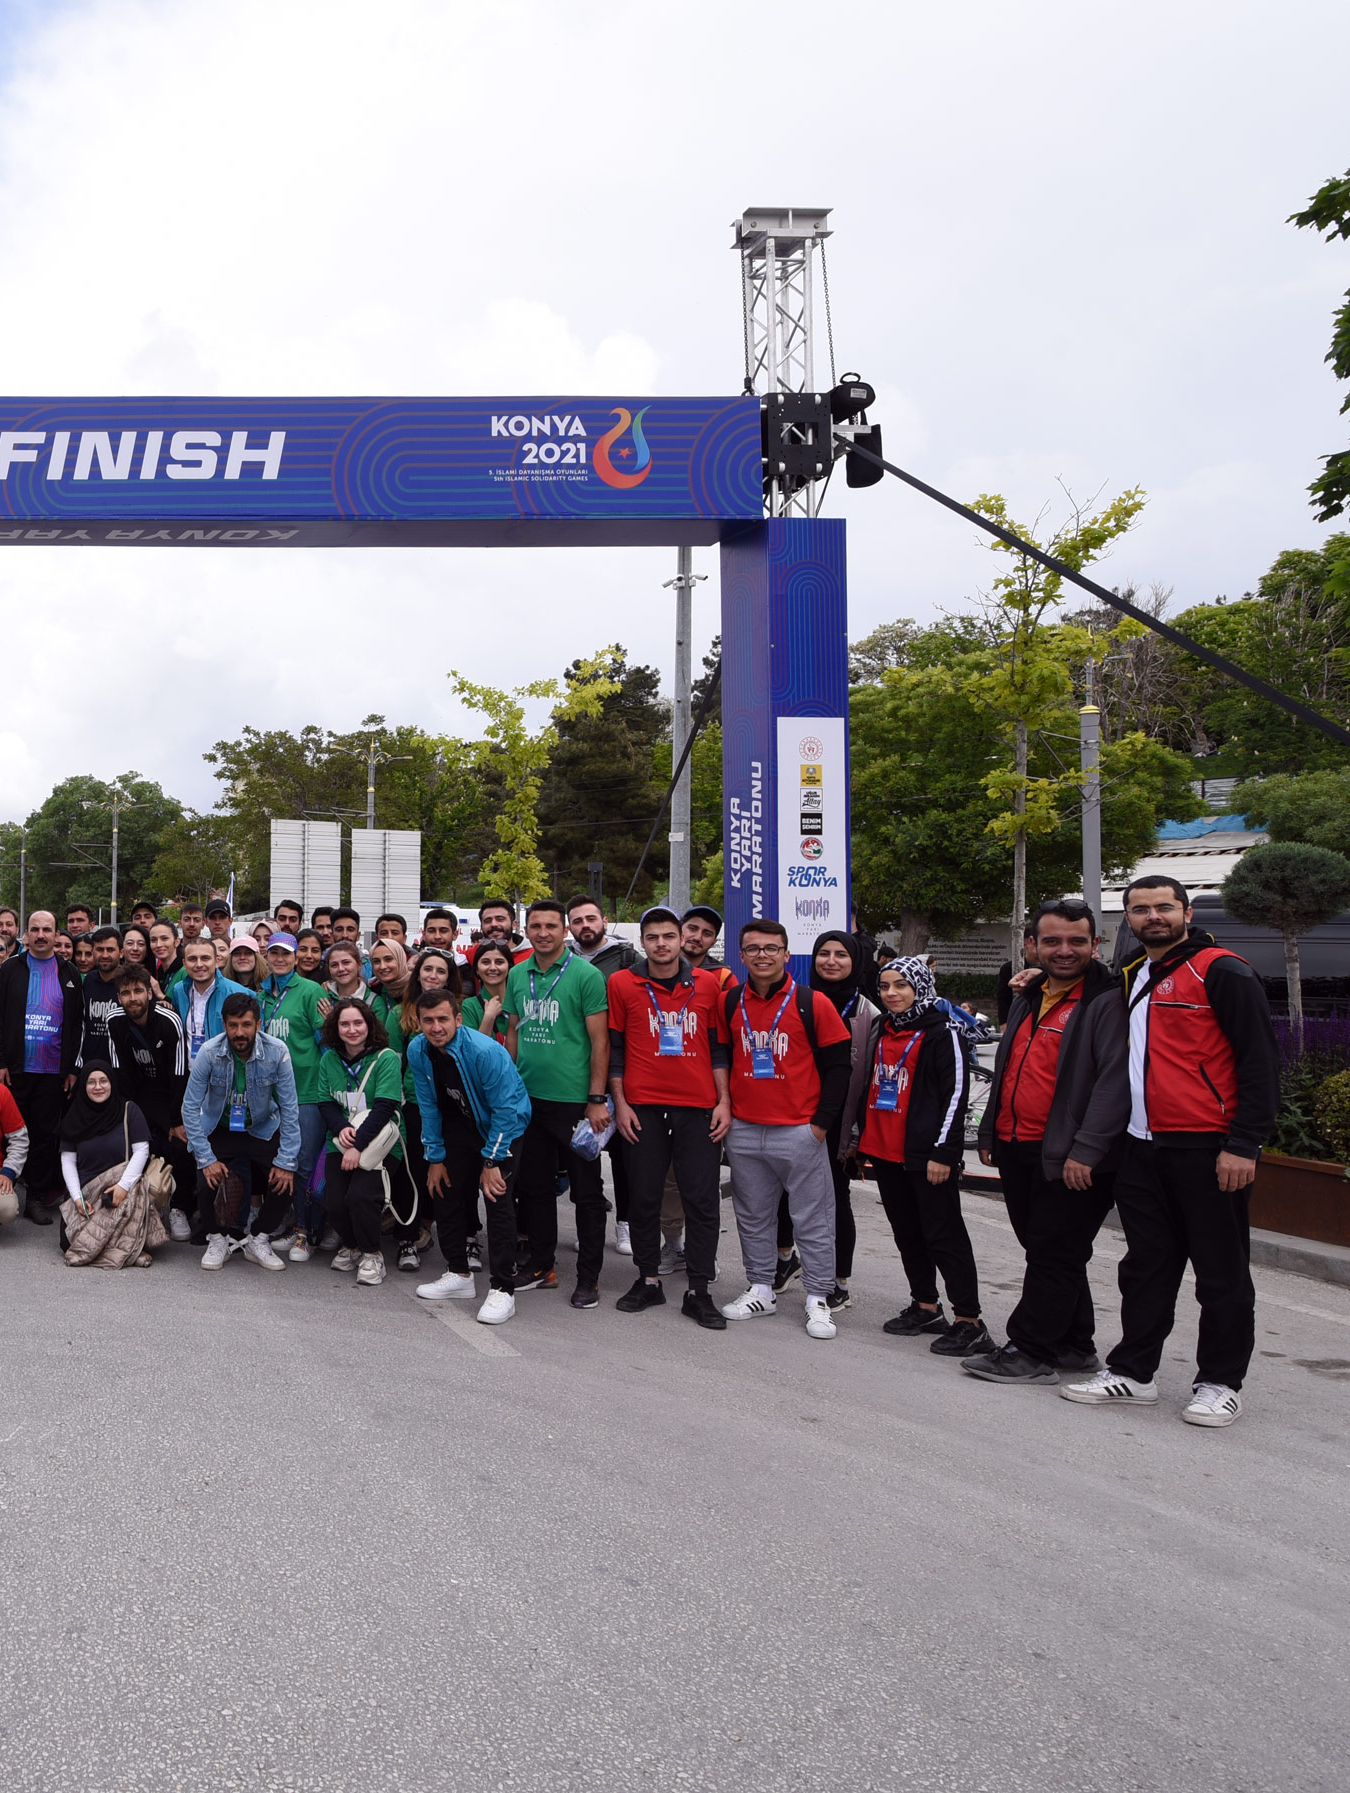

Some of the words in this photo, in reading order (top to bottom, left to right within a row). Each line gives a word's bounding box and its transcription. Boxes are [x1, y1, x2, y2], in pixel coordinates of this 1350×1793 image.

[491, 415, 587, 437] KONYA
[522, 443, 587, 464] 2021
[105, 529, 300, 541] KONYA
[730, 797, 741, 888] KONYA
[741, 811, 751, 873] YARI
[751, 761, 763, 919] MARATONU
[787, 866, 827, 877] SPOR
[788, 875, 838, 887] KONYA
[743, 1072, 785, 1080] MANU
